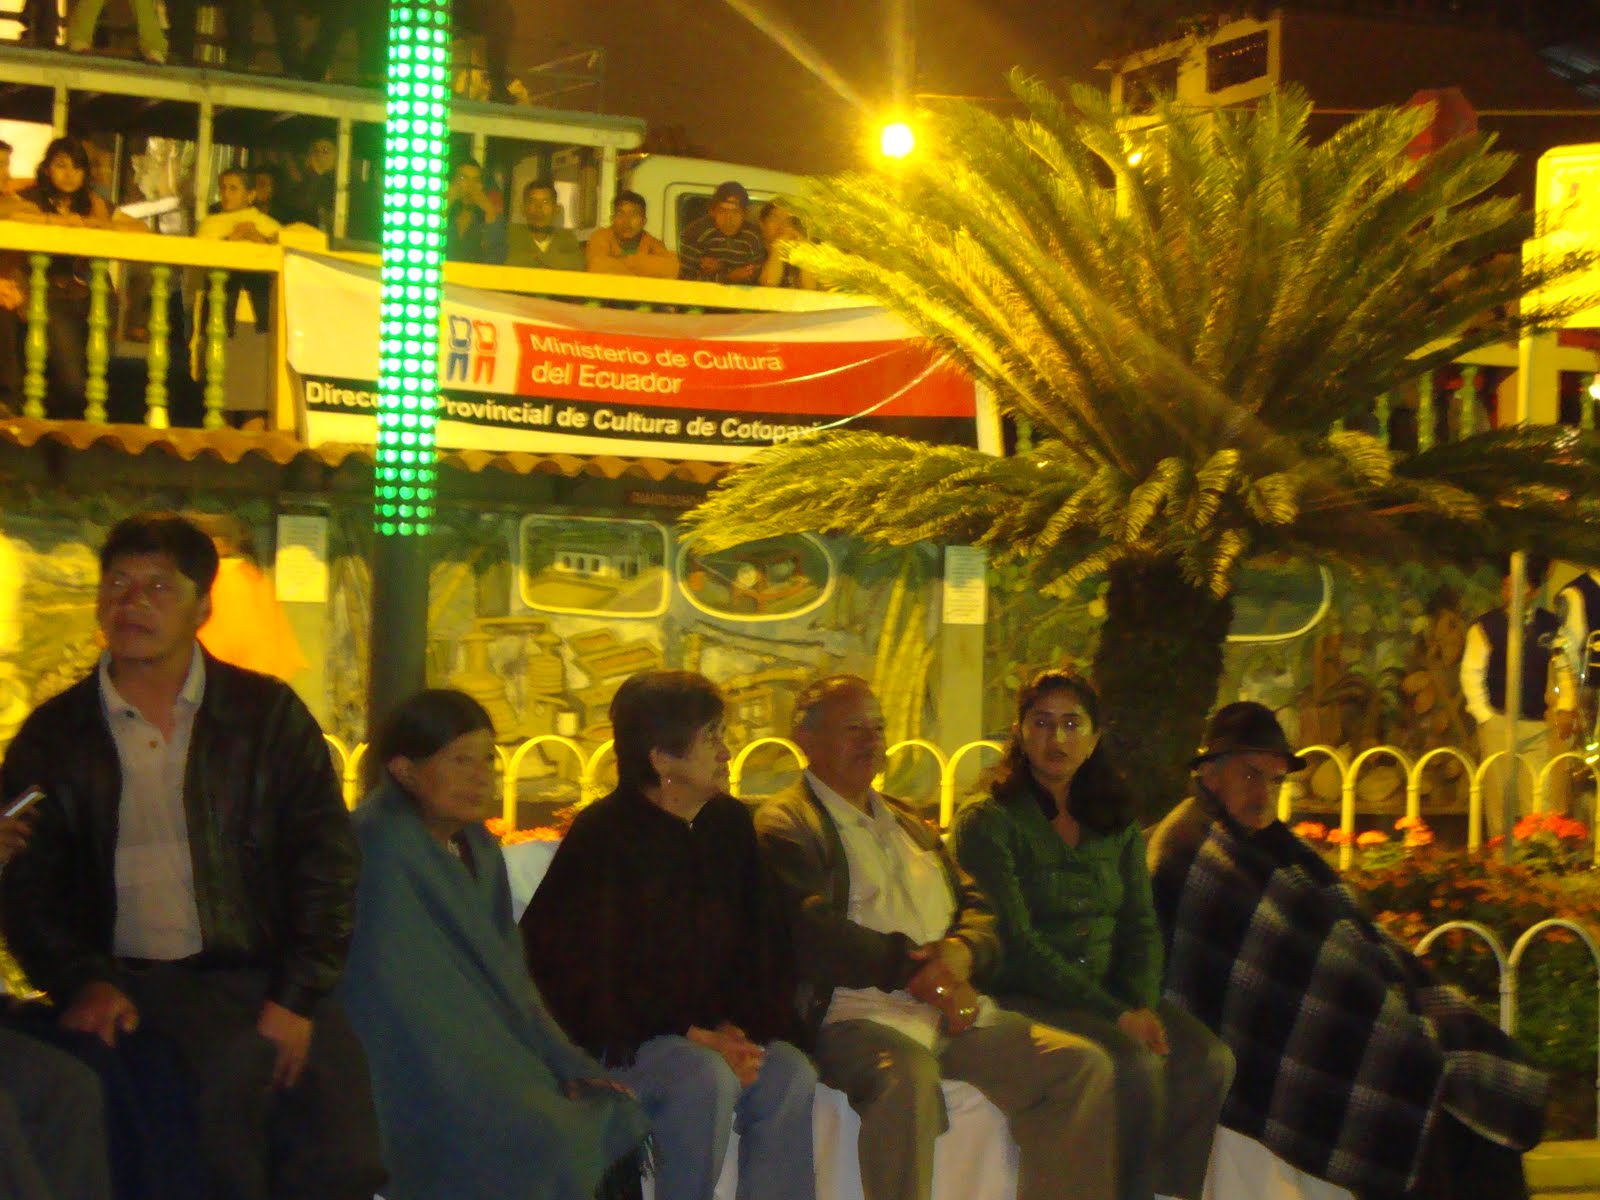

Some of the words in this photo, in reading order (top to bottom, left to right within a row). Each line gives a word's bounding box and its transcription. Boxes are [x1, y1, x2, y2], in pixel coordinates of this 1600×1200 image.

[529, 333, 651, 366] Ministerio
[655, 348, 689, 368] de
[693, 349, 784, 372] Cultura
[531, 360, 573, 386] del
[578, 363, 684, 394] Ecuador
[305, 380, 384, 409] Direcc
[556, 406, 590, 429] de
[593, 408, 682, 436] Cultura
[686, 416, 718, 438] de
